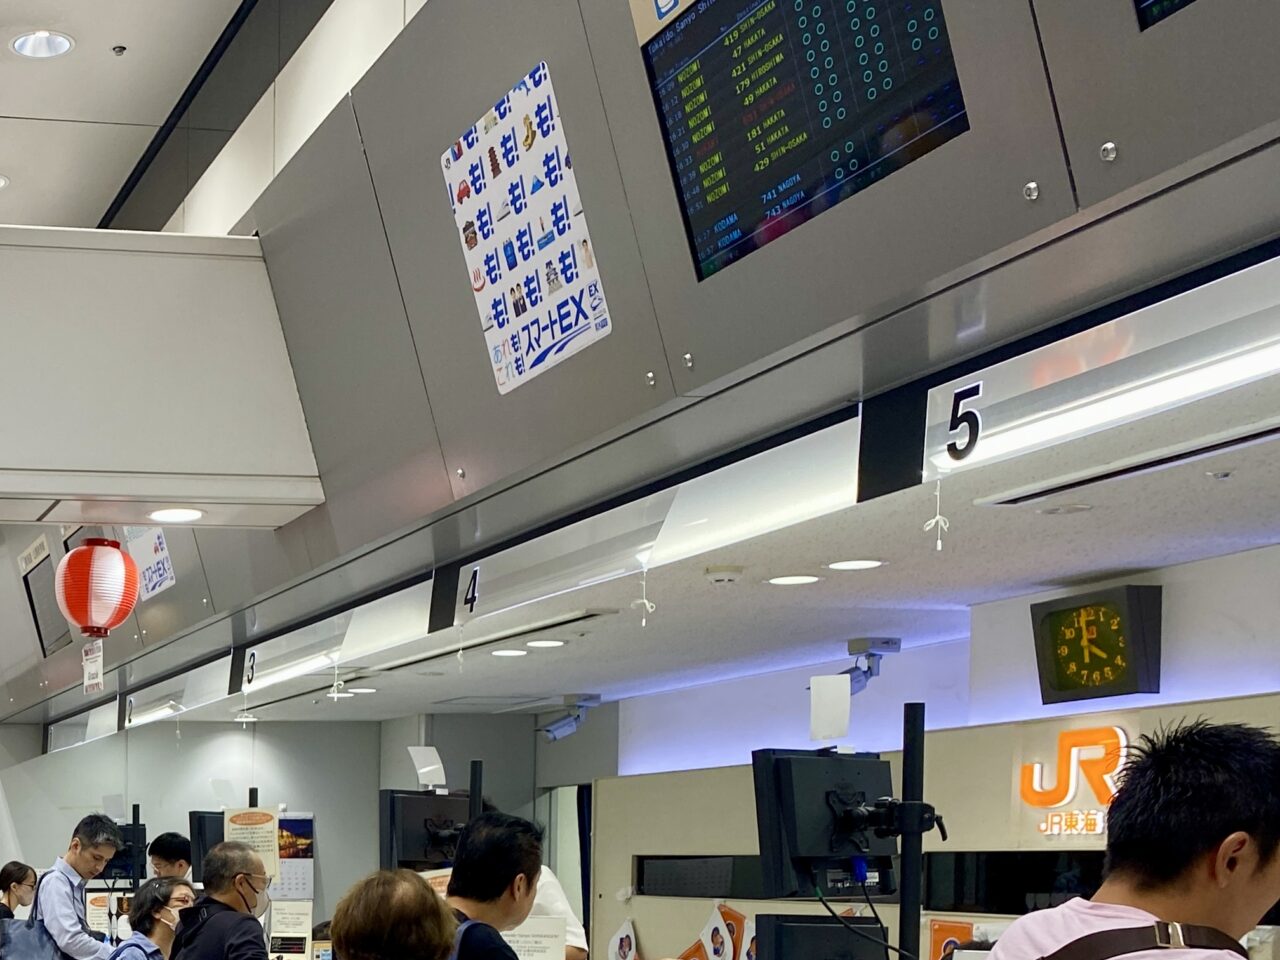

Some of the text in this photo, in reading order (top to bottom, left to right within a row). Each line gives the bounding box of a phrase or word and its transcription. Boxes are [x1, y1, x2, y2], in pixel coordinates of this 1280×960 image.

[648, 31, 674, 54] Tokaido
[676, 12, 695, 32] Sanyo
[677, 59, 700, 82] NOZOMI
[724, 31, 739, 46] 419
[740, 1, 776, 33] SHIN-OSAKA
[681, 75, 704, 98] NOZOMI
[732, 45, 742, 58] 47
[743, 28, 766, 48] HAKATA
[685, 90, 708, 113] NOZOMI
[731, 64, 747, 78] 421
[748, 33, 784, 65] SHIN-OSAKA
[688, 105, 712, 129] NOZOMI
[735, 78, 751, 95] 179
[751, 53, 784, 82] HIROSHIMA
[692, 121, 715, 143] NOZOMI
[743, 94, 754, 106] 49
[755, 77, 778, 98] HAKATA
[535, 94, 556, 139] も!
[500, 126, 520, 168] も!
[699, 152, 722, 174] NOZOMI
[746, 127, 762, 141] 181
[763, 109, 786, 128] HAKATA
[703, 167, 726, 188] NOZOMI
[755, 142, 766, 154] 51
[767, 126, 789, 145] HAKATA
[469, 155, 487, 195] も!
[543, 145, 563, 188] も!
[706, 182, 730, 204] NOZOMI
[754, 158, 770, 171] 429
[771, 132, 808, 161] SHIN-OSAKA
[508, 174, 527, 215] も!
[713, 213, 738, 233] KODAMA
[761, 191, 777, 204] 741
[778, 174, 801, 191] NAGOYA
[476, 202, 494, 241] も!
[551, 194, 571, 237] も!
[718, 229, 742, 249] KODAMA
[765, 206, 781, 219] 743
[782, 191, 806, 208] NAGOYA
[516, 221, 535, 262] も!
[484, 247, 502, 285] も!
[558, 243, 579, 285] も!
[524, 269, 543, 308] も!
[588, 280, 599, 297] EX
[492, 292, 510, 330] も!
[522, 288, 590, 357] スマートEX
[492, 331, 522, 364] あれも!
[496, 353, 526, 386] これも!
[947, 381, 982, 461] 5
[464, 568, 480, 613] 4
[1064, 628, 1076, 640] 10
[1110, 618, 1119, 630] 2
[247, 651, 256, 684] 3
[1060, 645, 1069, 656] 9
[1069, 662, 1077, 673] 8
[1114, 655, 1122, 666] 4
[1081, 670, 1089, 681] 7
[1093, 671, 1100, 682] 6
[1104, 667, 1112, 678] 5
[1020, 727, 1125, 808] JR
[1038, 811, 1104, 834] JR東海
